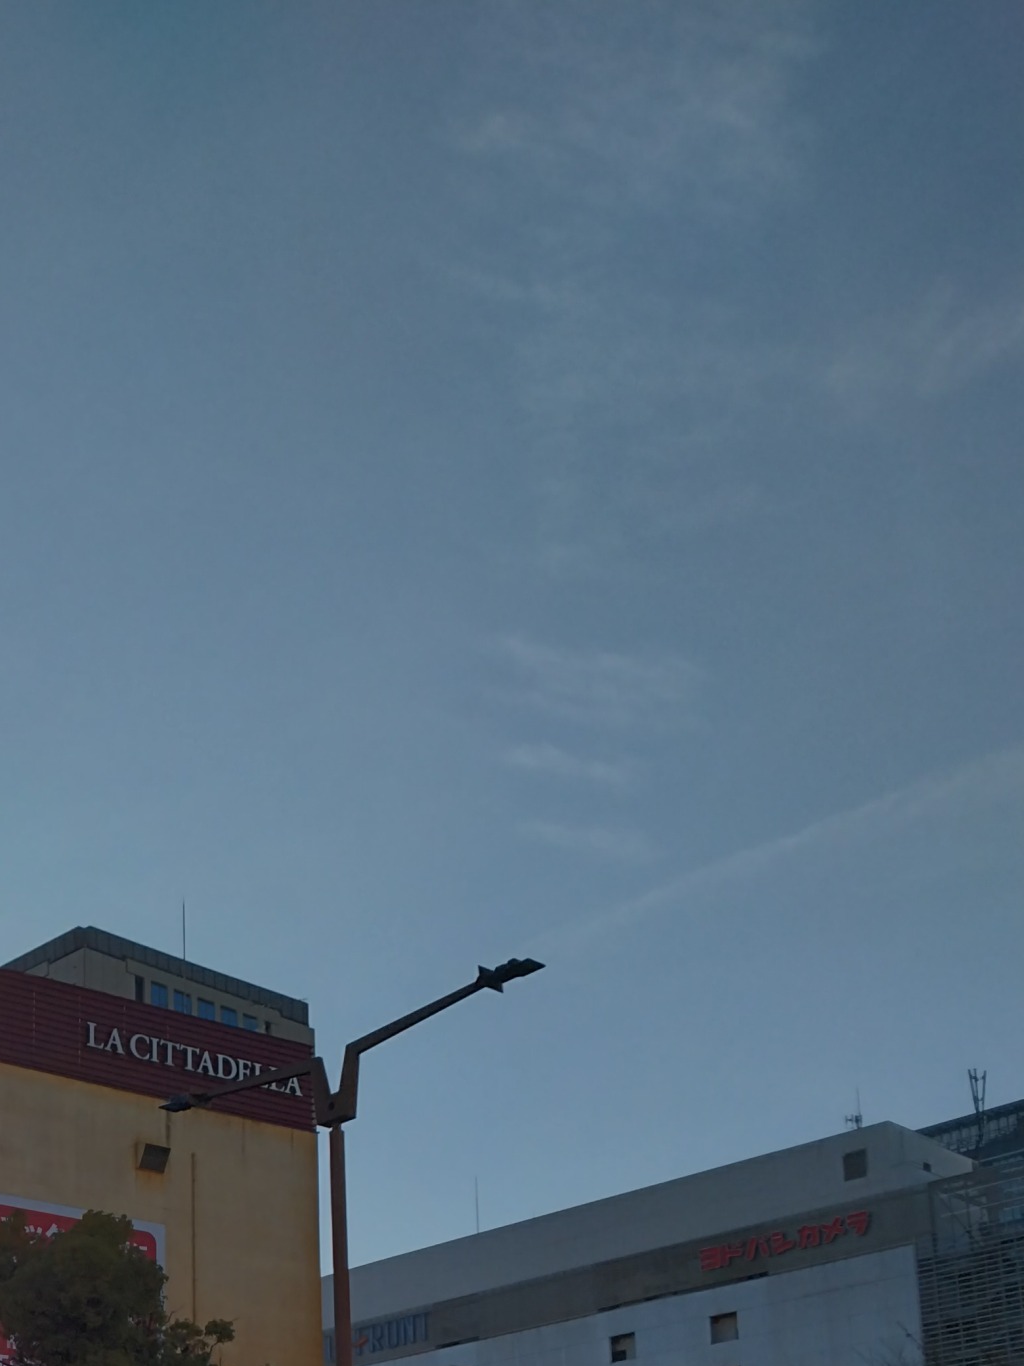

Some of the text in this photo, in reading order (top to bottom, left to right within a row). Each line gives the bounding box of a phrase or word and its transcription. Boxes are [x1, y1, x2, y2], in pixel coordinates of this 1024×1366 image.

[86, 1021, 125, 1055] LA
[699, 1210, 868, 1272] ヨドバシカメラ
